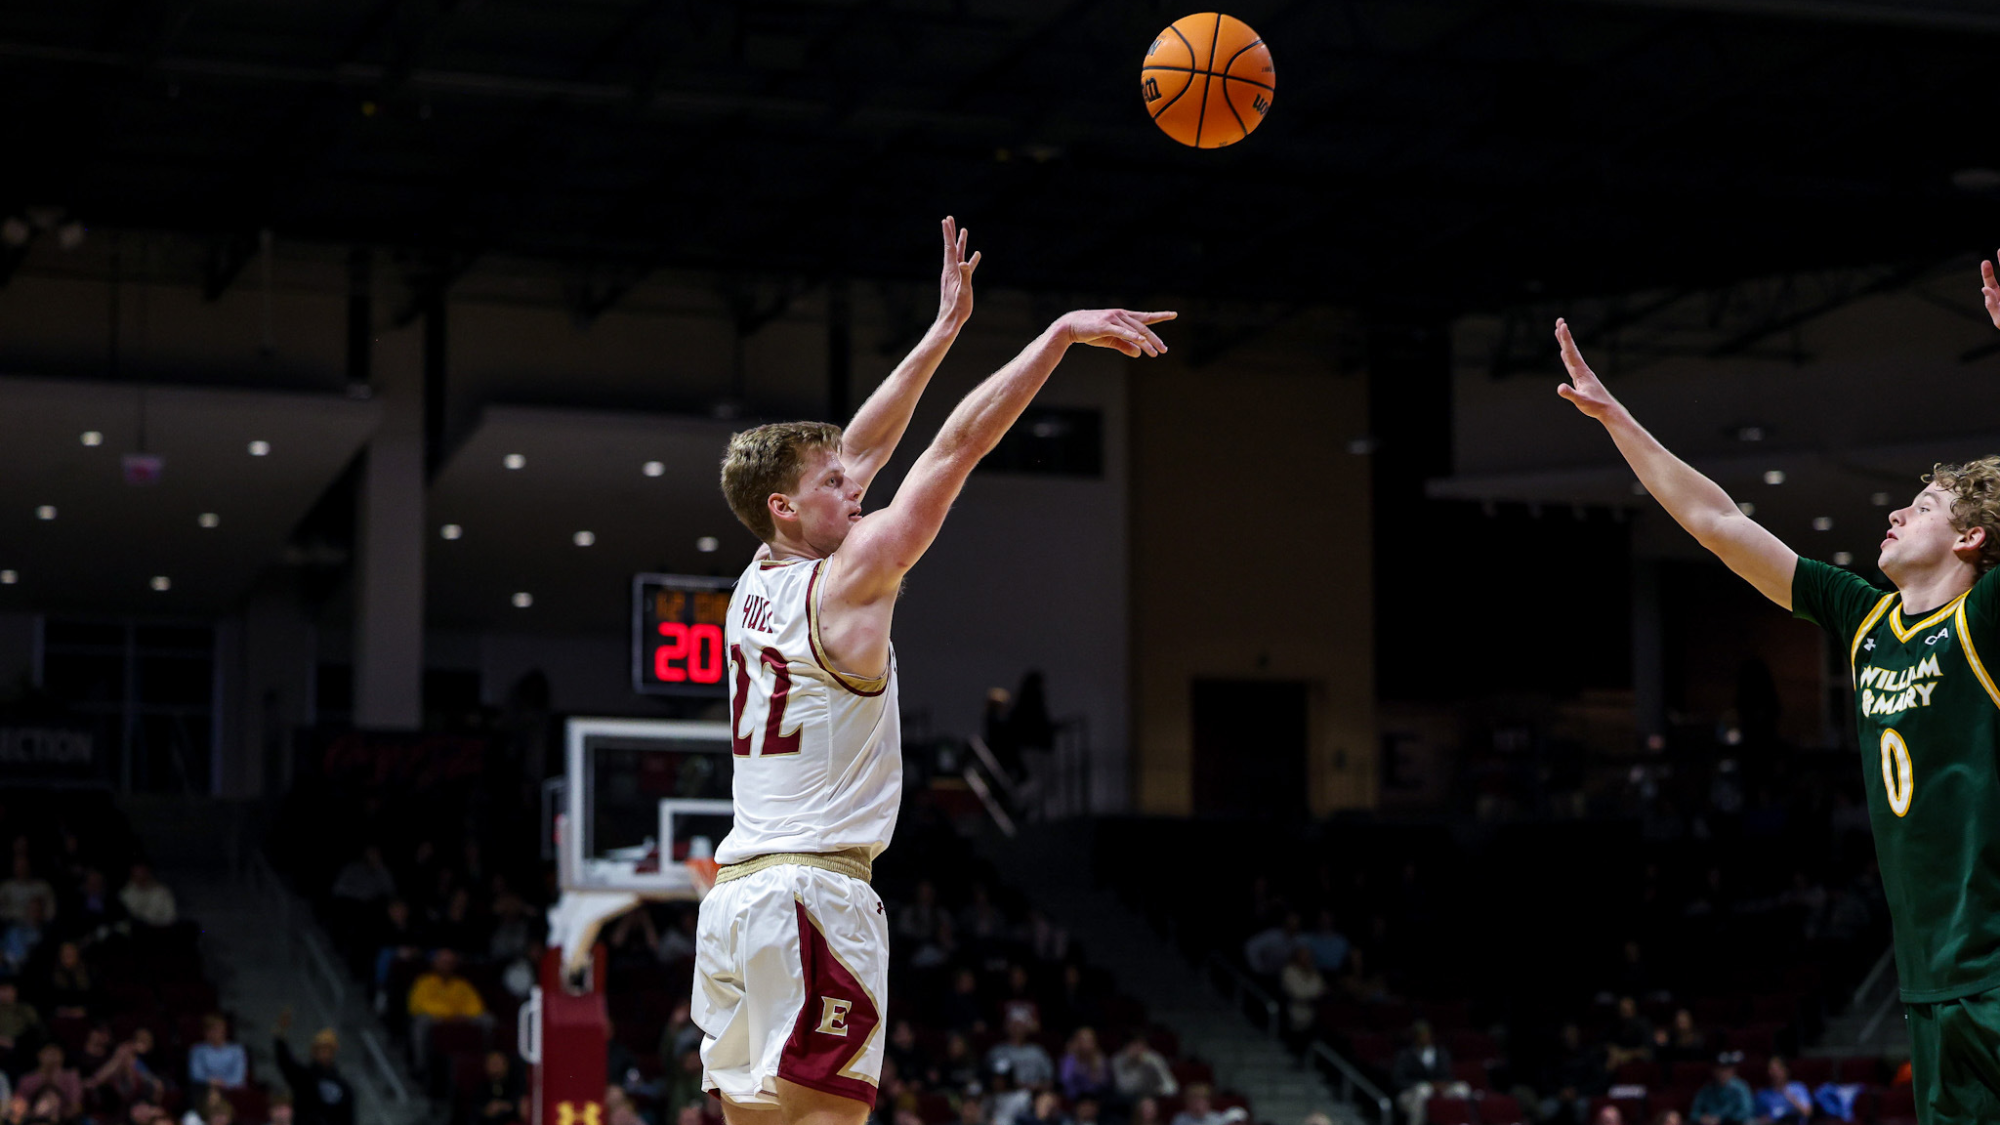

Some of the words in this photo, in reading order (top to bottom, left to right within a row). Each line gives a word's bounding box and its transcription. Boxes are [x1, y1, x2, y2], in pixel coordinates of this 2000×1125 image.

[654, 621, 723, 684] 20
[730, 643, 804, 759] 22
[1880, 727, 1914, 818] 0
[815, 996, 852, 1037] E
